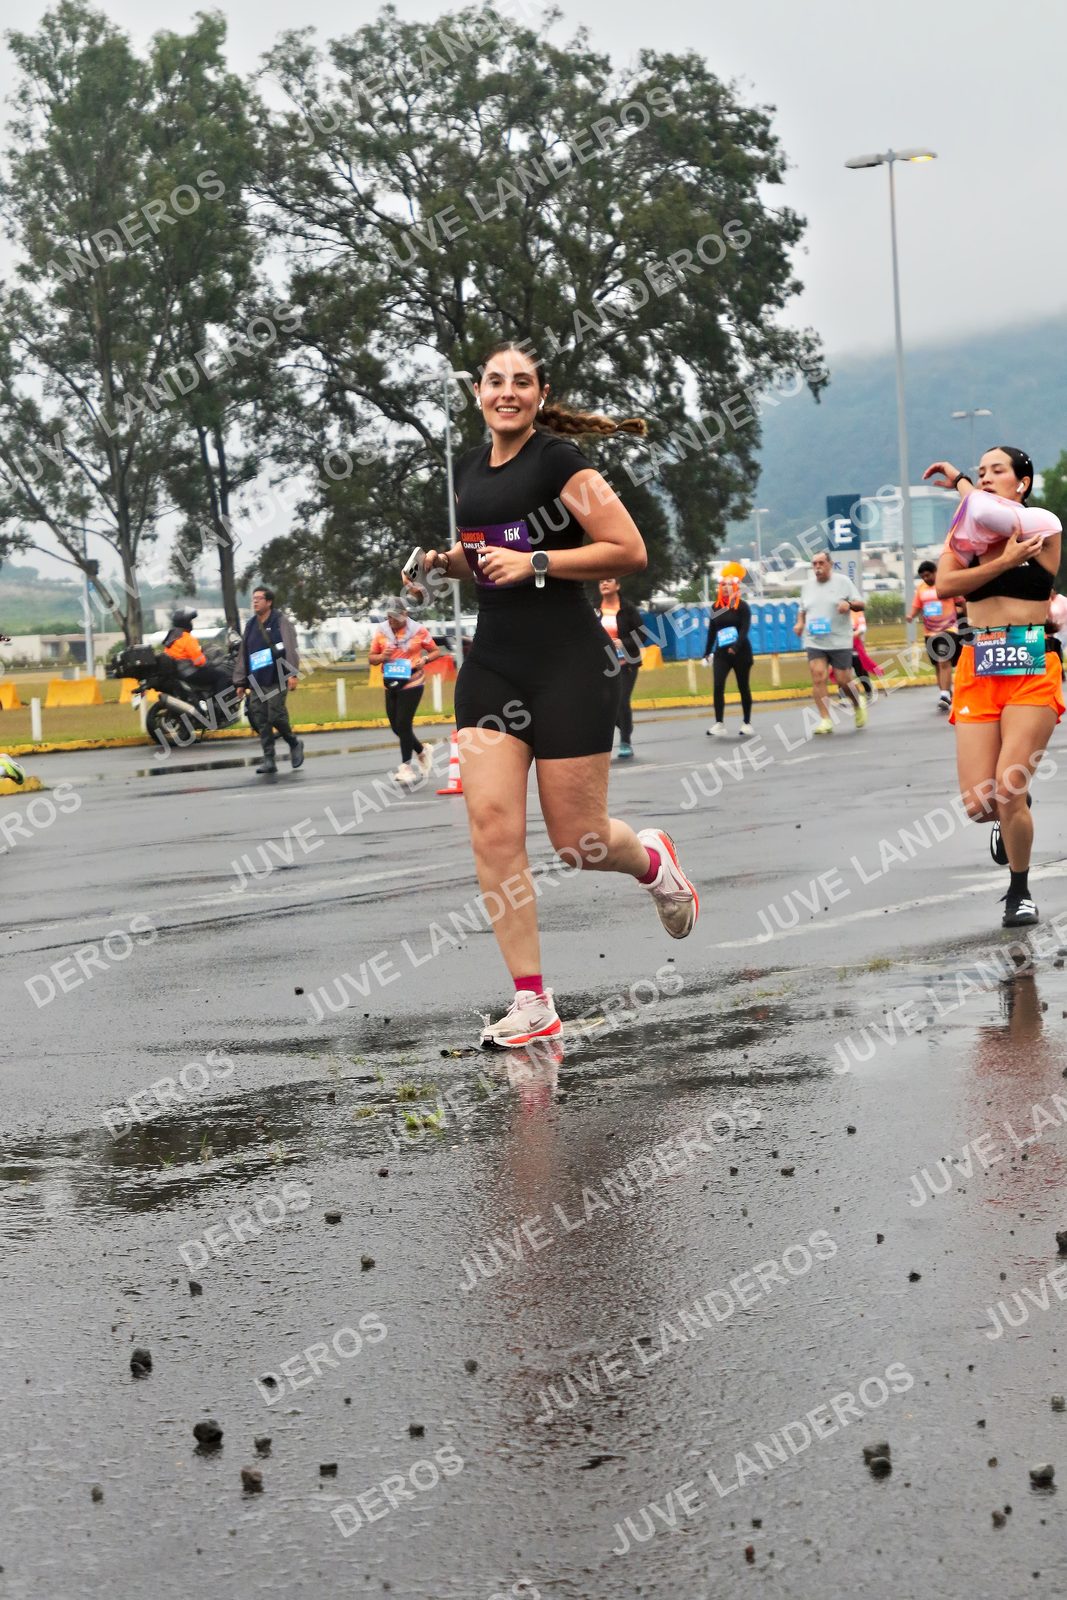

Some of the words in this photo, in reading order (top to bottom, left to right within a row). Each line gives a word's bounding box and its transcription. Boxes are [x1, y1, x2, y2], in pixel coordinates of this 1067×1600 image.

[504, 527, 521, 542] 16K
[834, 518, 852, 544] E
[985, 646, 1028, 662] 1326
